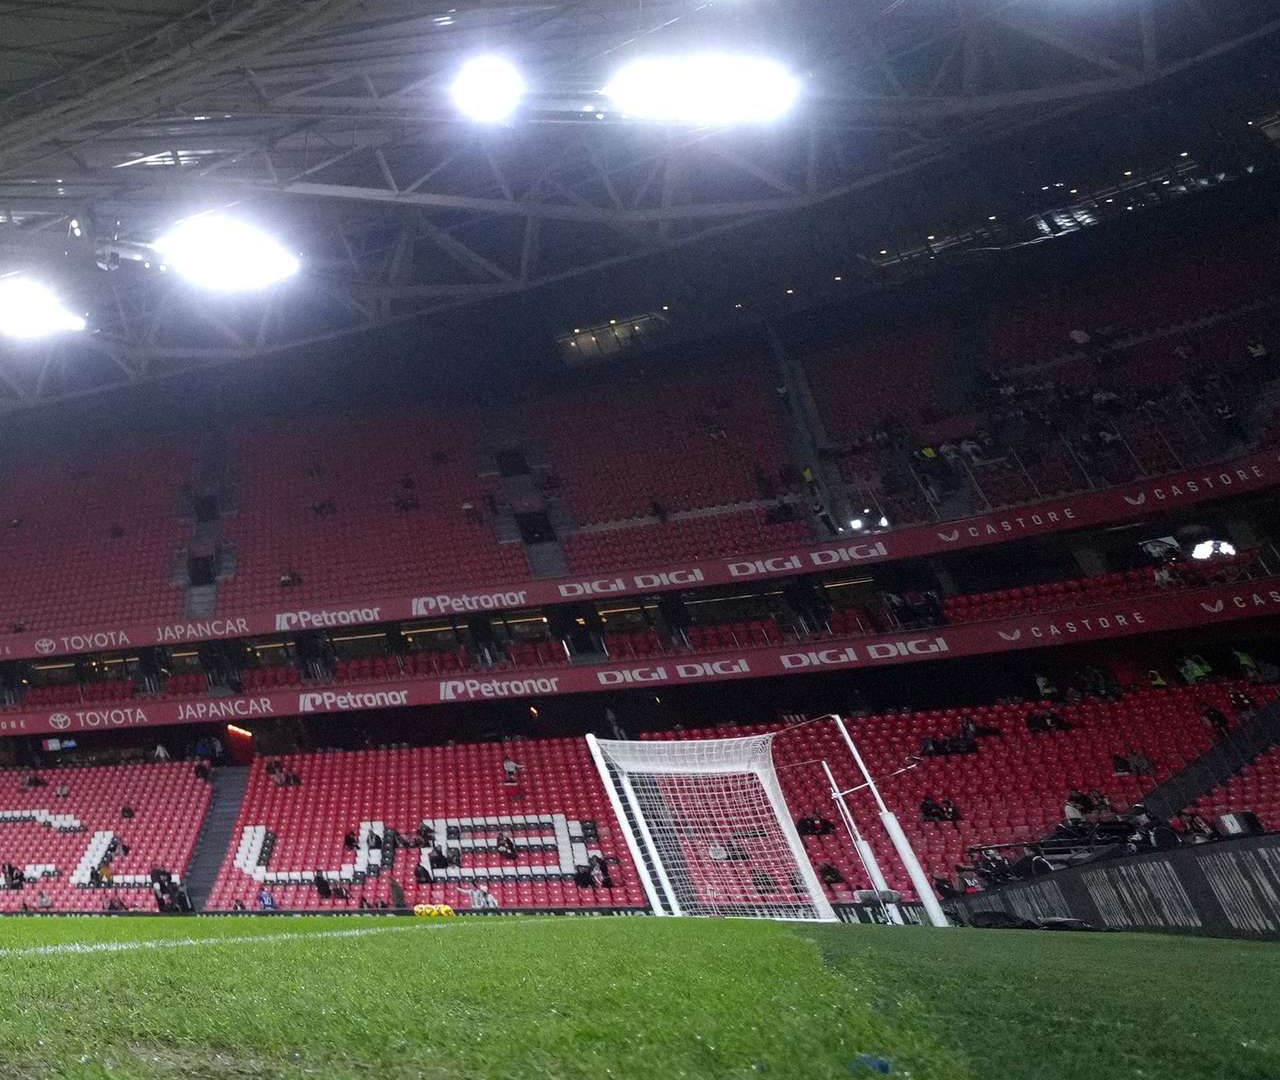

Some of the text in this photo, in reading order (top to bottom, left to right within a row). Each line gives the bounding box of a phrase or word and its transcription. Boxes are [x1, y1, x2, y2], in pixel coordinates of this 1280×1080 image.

[1154, 465, 1263, 500] CASTORE
[967, 508, 1074, 537] CASTORE
[728, 542, 888, 577] DIGI DIGI
[558, 568, 705, 598] DIGI DIGI
[437, 591, 527, 614] Petronor
[155, 618, 249, 642] JAPANCAR
[298, 607, 381, 629] Petronor
[1031, 612, 1146, 639] CASTORE
[60, 632, 130, 652] TOYOTA
[780, 636, 949, 670] DIGI DIGI
[597, 659, 750, 686] DIGI DIGI
[324, 688, 409, 709] Petronor
[465, 677, 560, 699] Petronor
[75, 708, 148, 728] TOYOTA
[176, 698, 274, 721] JAPANCAR
